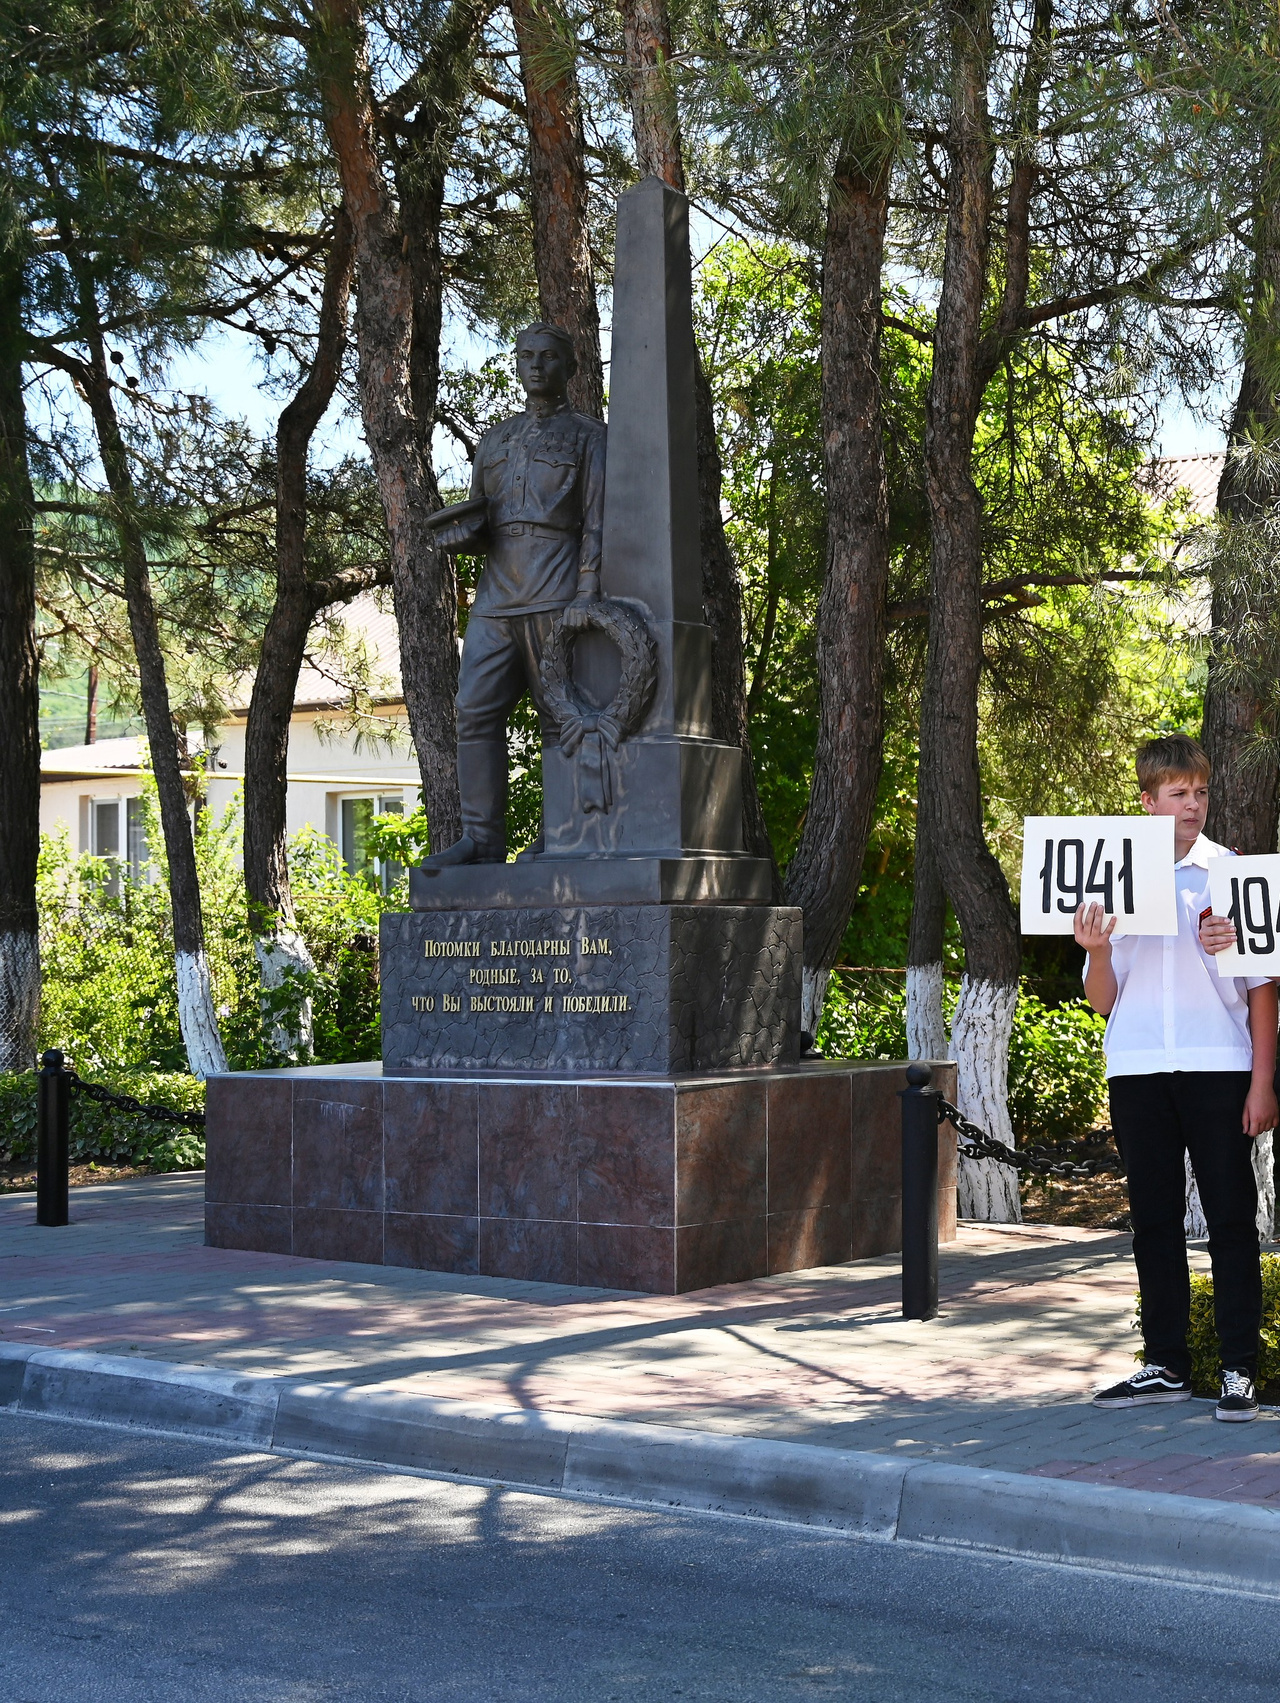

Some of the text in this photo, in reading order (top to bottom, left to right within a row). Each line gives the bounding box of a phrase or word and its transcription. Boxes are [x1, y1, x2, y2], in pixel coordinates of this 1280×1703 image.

[1040, 838, 1135, 915] 1941
[530, 968, 544, 984] ЗА
[553, 967, 572, 985] ТО,
[411, 996, 435, 1012] ЧТО
[470, 996, 535, 1012] ВЫСТОЯЛИ
[544, 996, 553, 1012] И
[562, 995, 632, 1014] ПОБЕДИЛИ.
